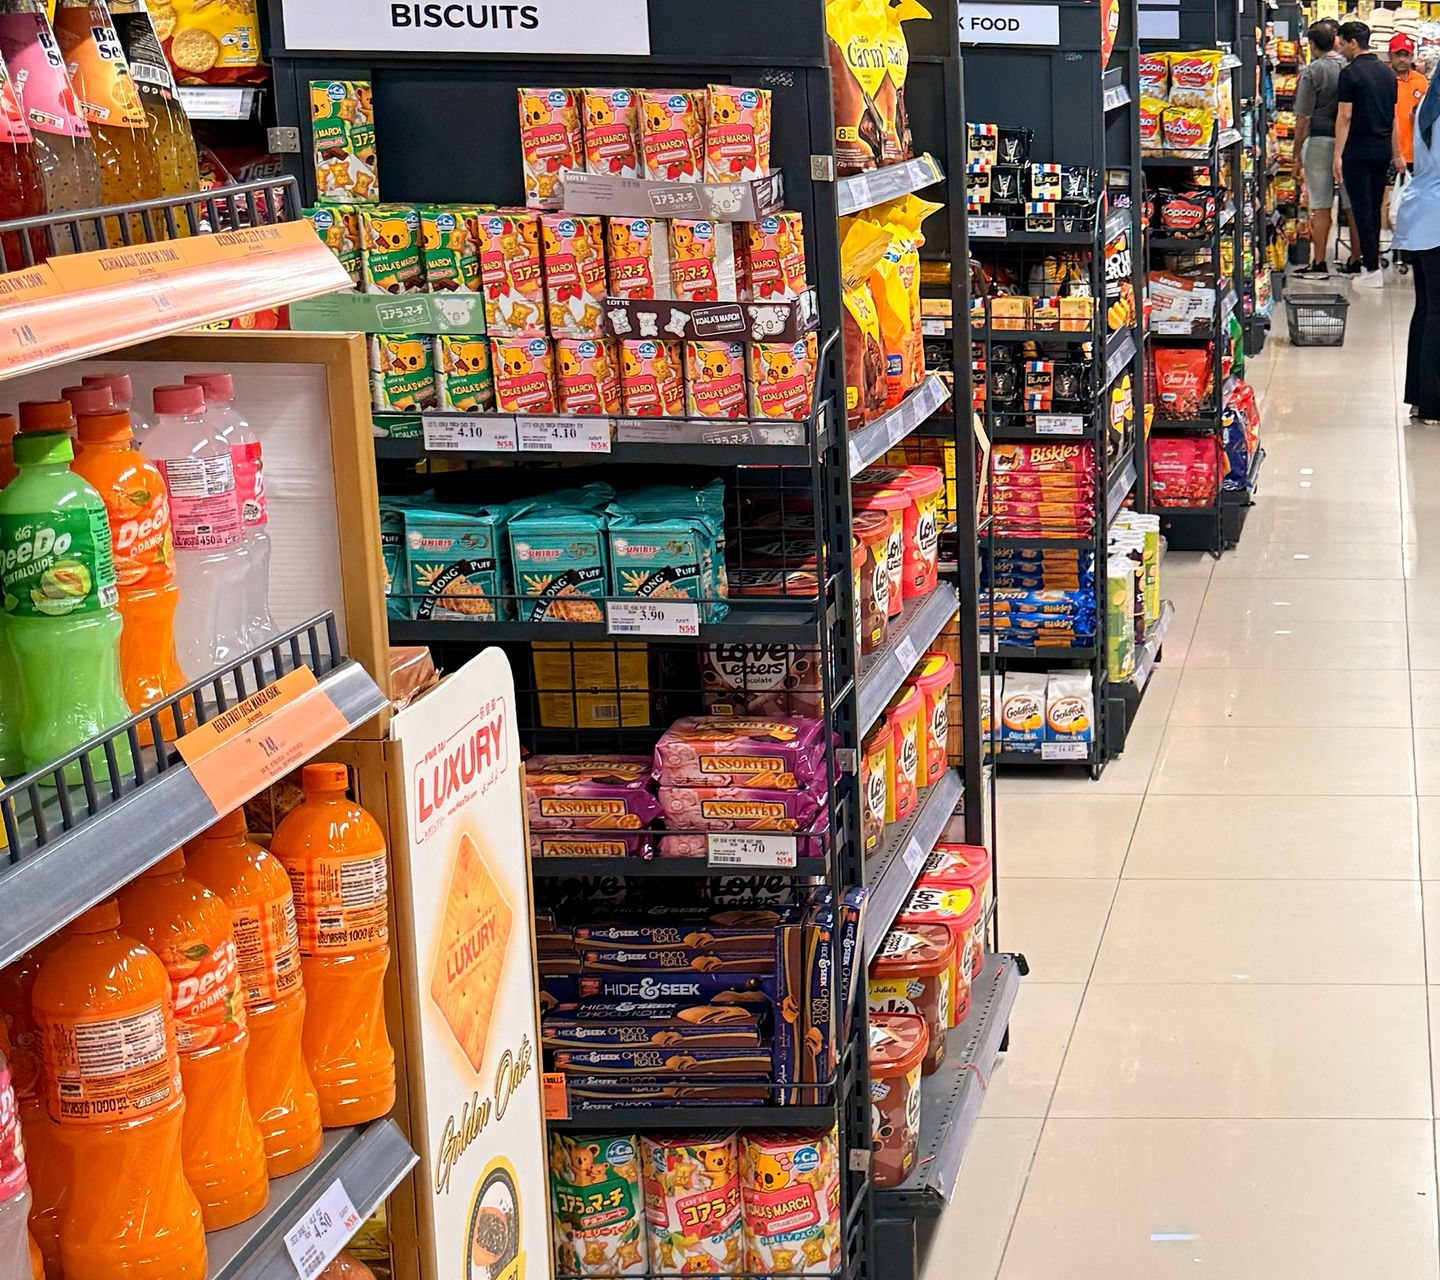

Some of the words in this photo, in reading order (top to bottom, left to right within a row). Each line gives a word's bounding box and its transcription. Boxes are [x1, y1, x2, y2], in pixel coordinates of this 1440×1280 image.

[391, 3, 540, 30] BISCUITS
[970, 17, 1021, 32] FOOD
[238, 163, 283, 180] TIGER
[606, 298, 630, 307] LOTTE
[457, 427, 483, 438] 4.10
[551, 427, 577, 439] 4.10
[1029, 443, 1081, 463] Biskies
[469, 559, 491, 571] PUFF
[640, 609, 665, 622] 3.90
[733, 676, 773, 687] Chocolate
[1006, 704, 1039, 720] Goldfish
[1053, 705, 1087, 721] Goldfish
[418, 714, 503, 823] LUXURY
[702, 757, 785, 773] ASSORTED
[542, 801, 626, 816] ASSORTED
[702, 802, 788, 818] ASSORTED
[740, 842, 767, 854] 4.70
[445, 913, 497, 985] LUXURY
[91, 1098, 119, 1114] 1000
[780, 1194, 811, 1216] MARCH
